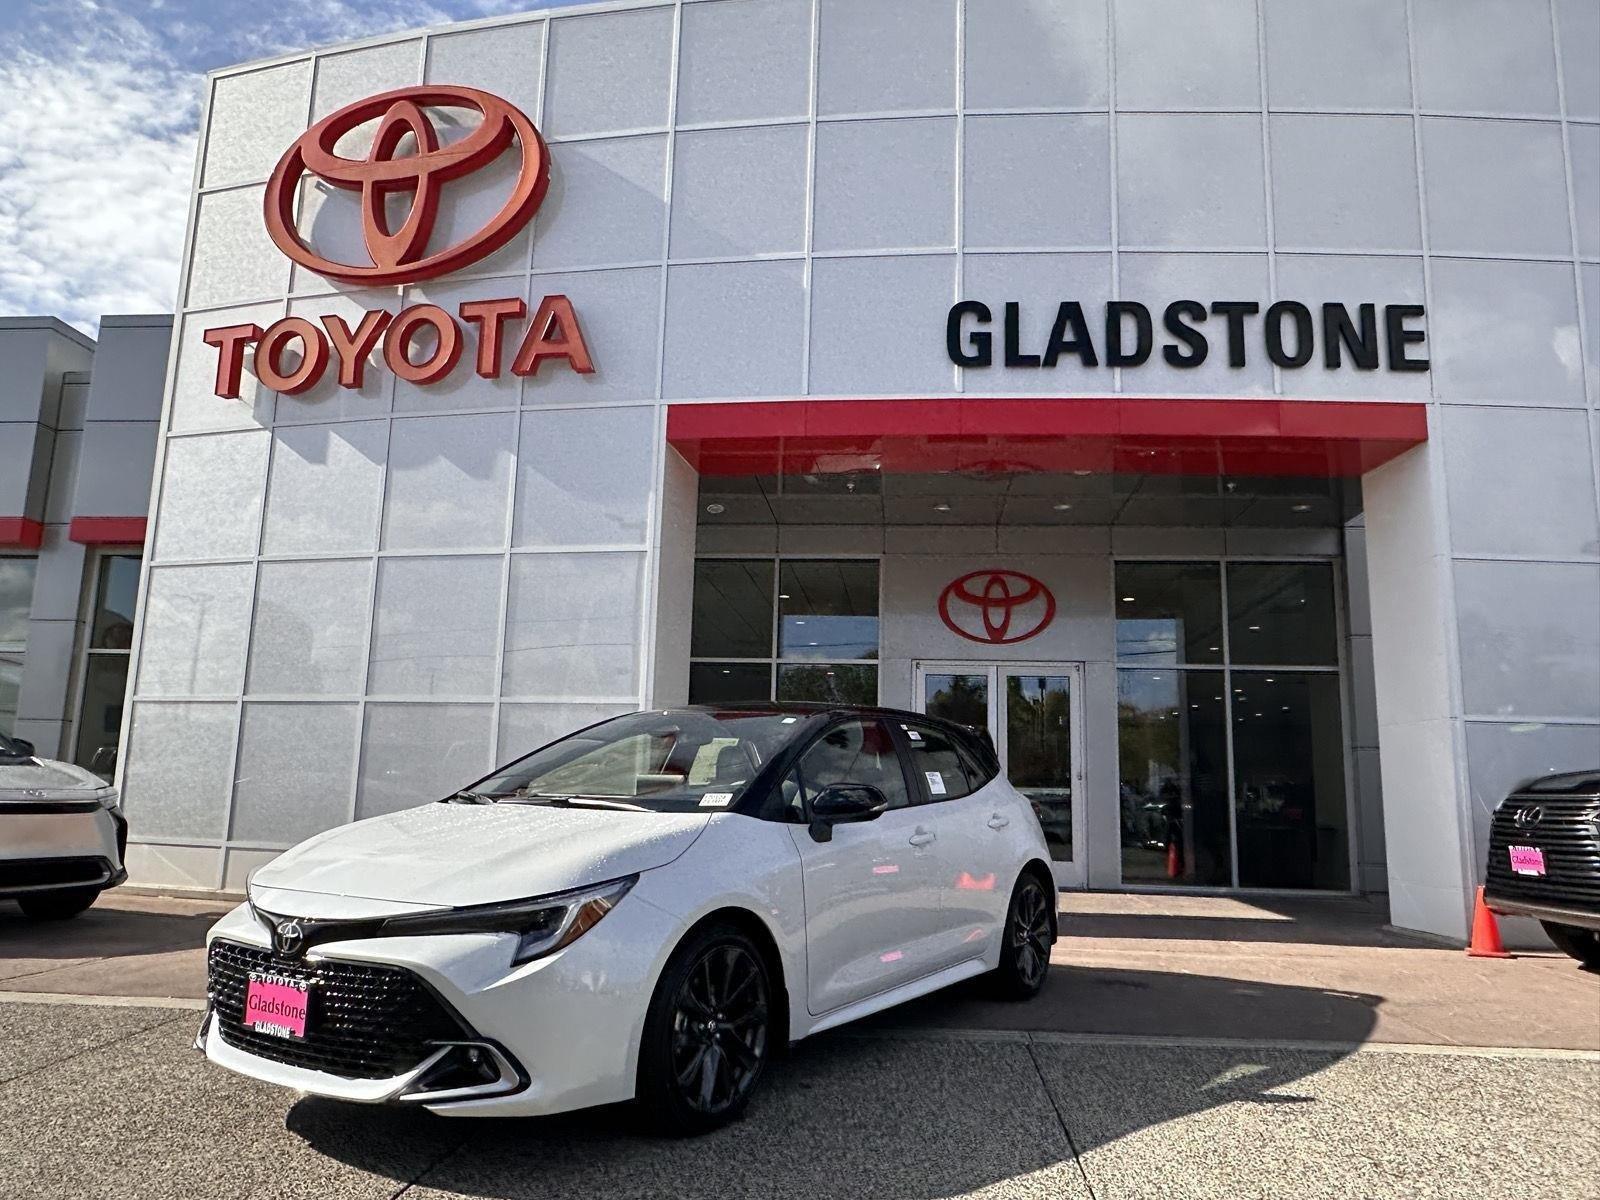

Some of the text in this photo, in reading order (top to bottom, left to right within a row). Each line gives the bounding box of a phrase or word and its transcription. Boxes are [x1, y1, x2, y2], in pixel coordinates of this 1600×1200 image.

[203, 295, 595, 399] TOYOTA
[946, 300, 1429, 370] GLADSTONE
[262, 974, 295, 988] TOYOTA
[249, 994, 306, 1020] Gladstone
[255, 1021, 291, 1039] GLADSTONE
